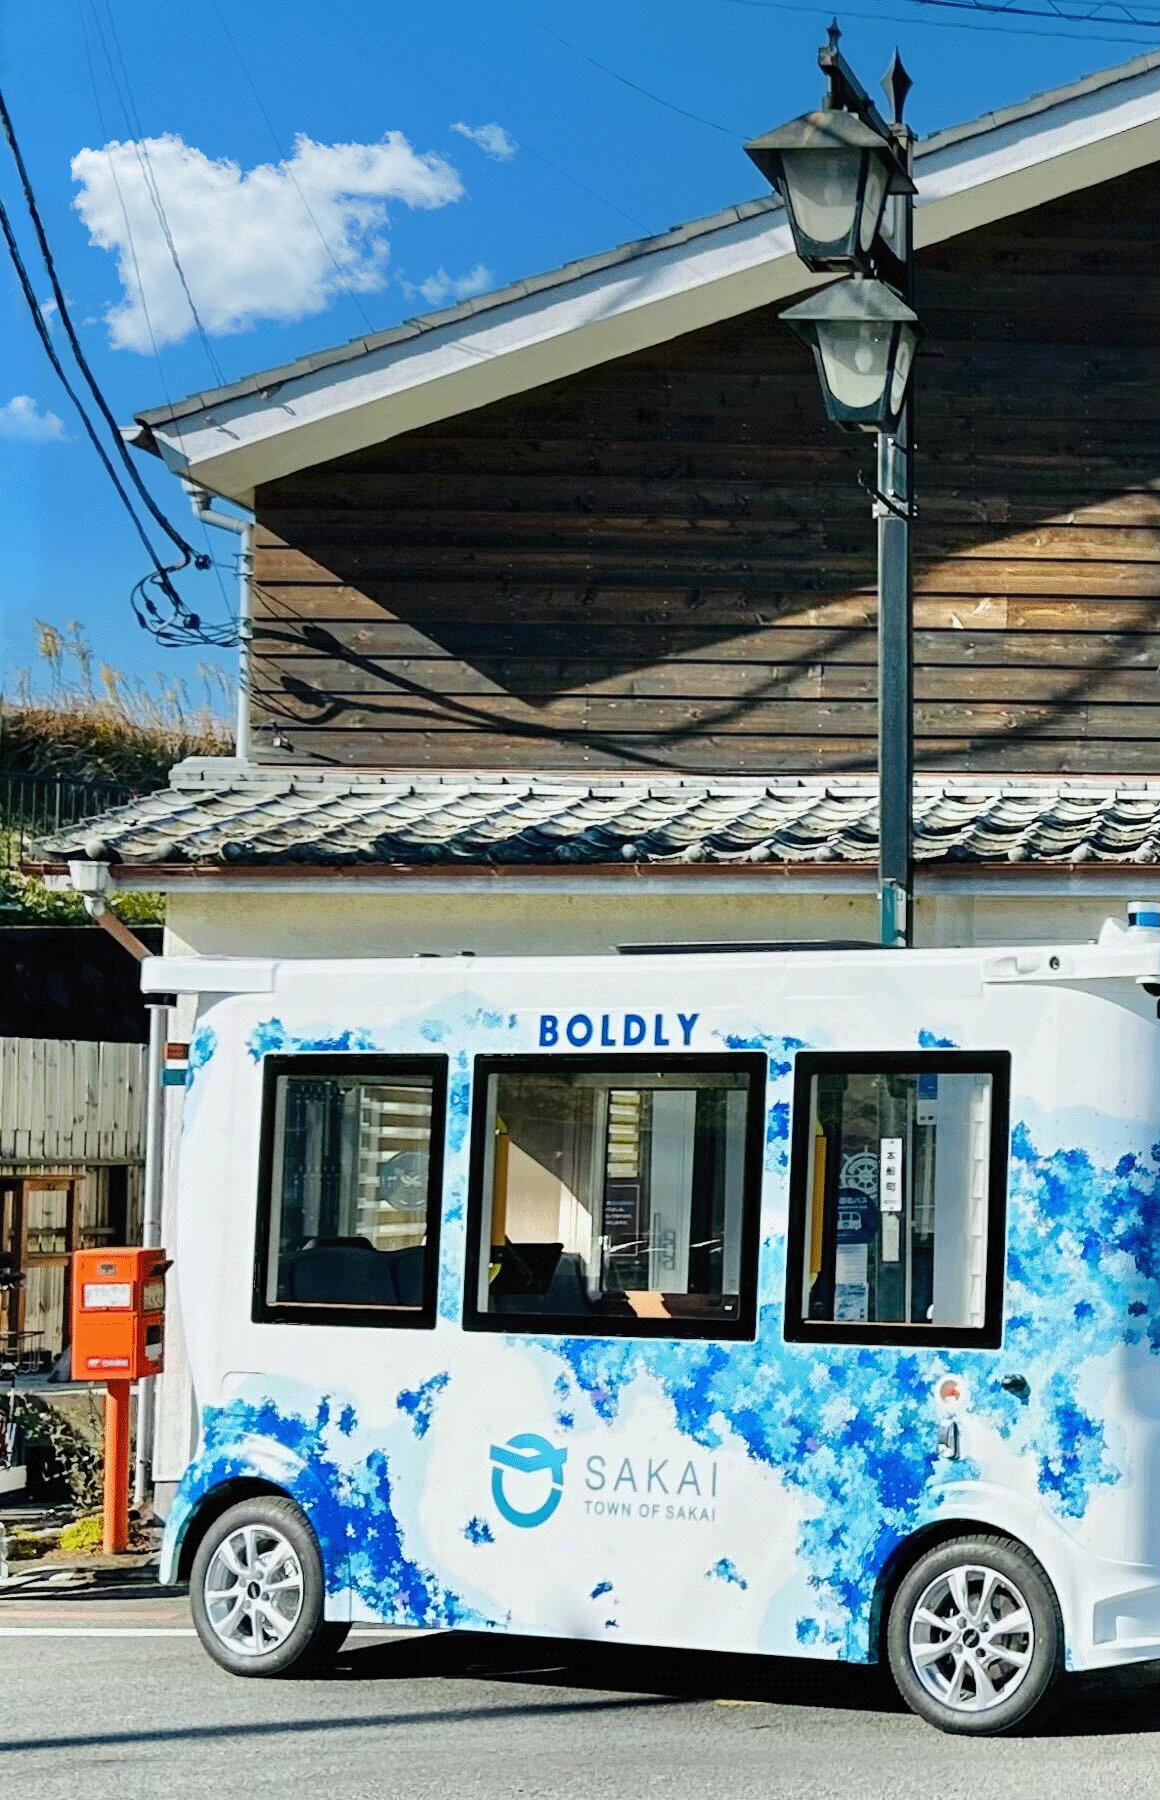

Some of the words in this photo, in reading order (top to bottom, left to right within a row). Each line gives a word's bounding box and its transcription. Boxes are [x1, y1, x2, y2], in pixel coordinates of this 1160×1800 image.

[538, 1013, 700, 1047] BOLDLY
[584, 1455, 718, 1497] SAKAI
[584, 1500, 632, 1517] TOWN
[639, 1503, 661, 1519] OF
[665, 1505, 716, 1522] SAKAI
